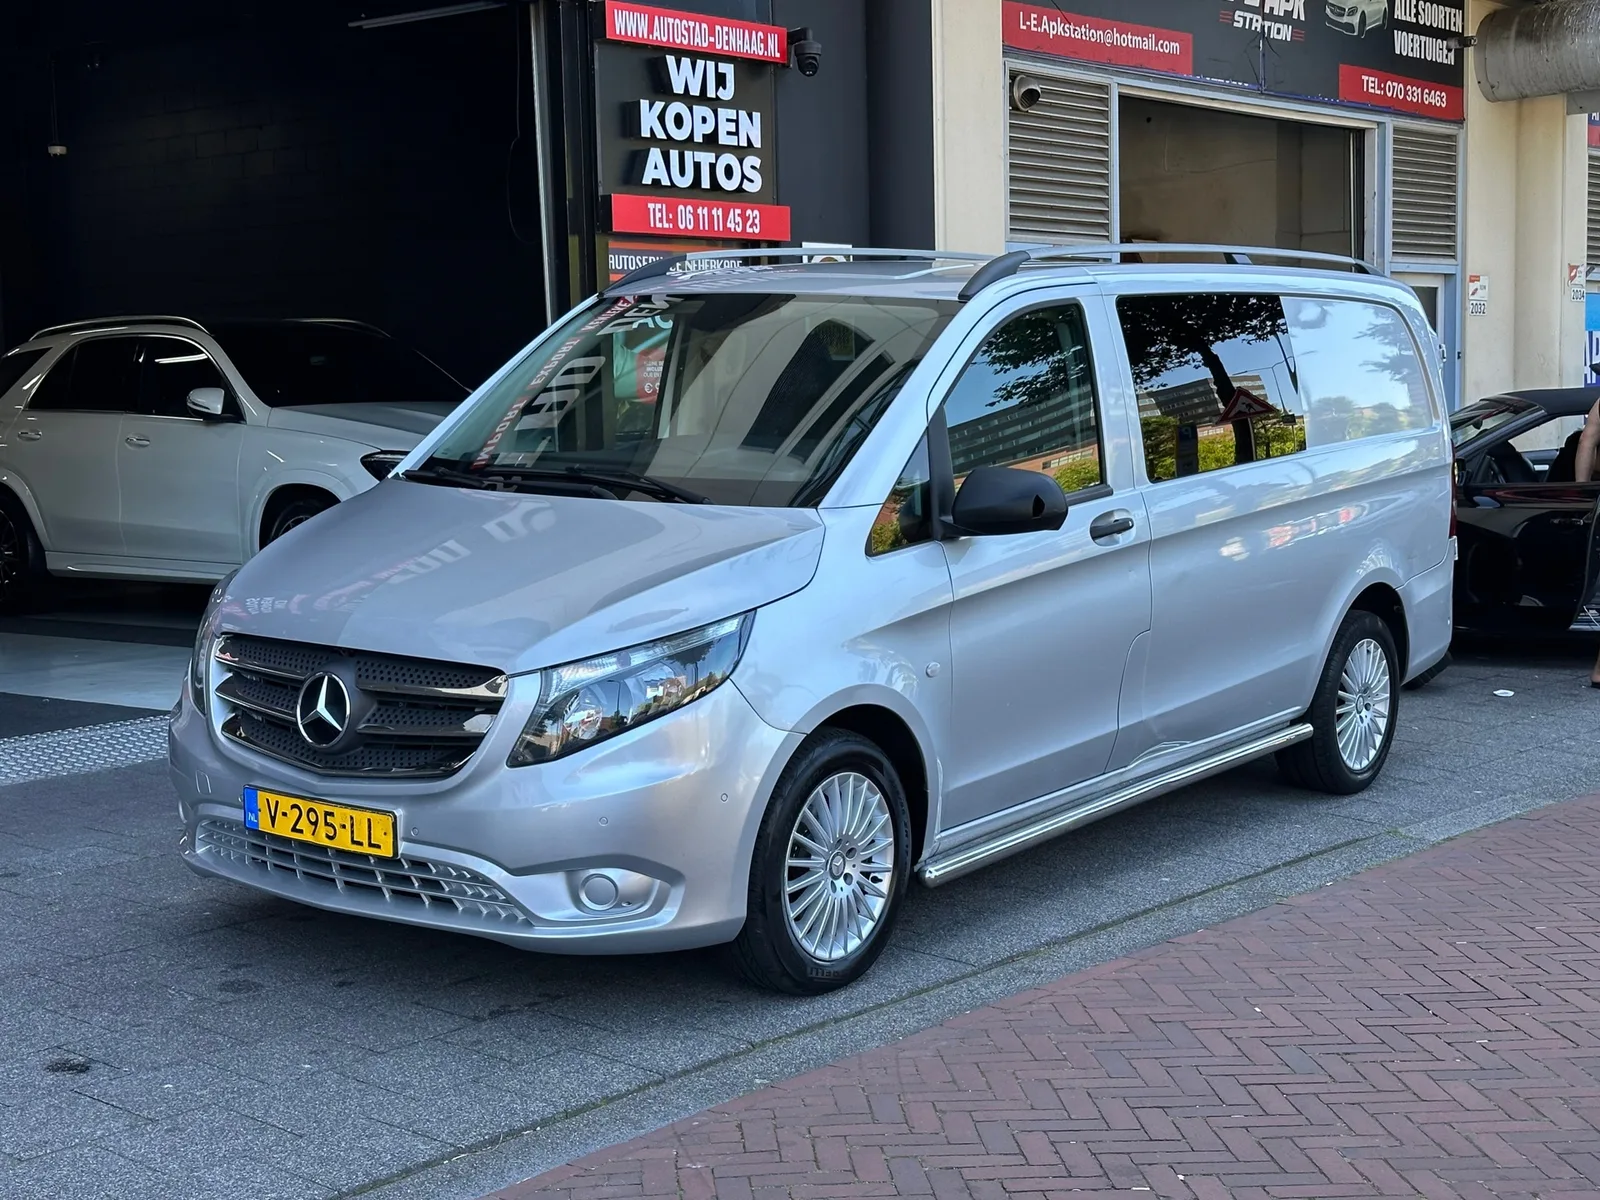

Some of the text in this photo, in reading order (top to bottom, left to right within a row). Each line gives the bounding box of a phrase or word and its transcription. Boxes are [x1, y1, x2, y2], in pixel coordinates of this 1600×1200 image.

[614, 9, 780, 57] WWW.AUTOSTAD-DENHAAG.NL
[1019, 11, 1180, 55] L-E.Apkstation@hotmail.com
[1233, 10, 1292, 41] STATION
[1394, 0, 1463, 33] ALLE SOORTEN
[666, 55, 735, 100] WIJ
[1361, 75, 1447, 108] TEL: 070 331 6463
[640, 99, 762, 148] KOPEN
[642, 148, 763, 193] AUTOS
[647, 203, 760, 234] TEL: 06 11 11 45 23
[1470, 302, 1486, 314] 2032
[248, 812, 258, 823] NL
[266, 798, 381, 850] V-295-LL
